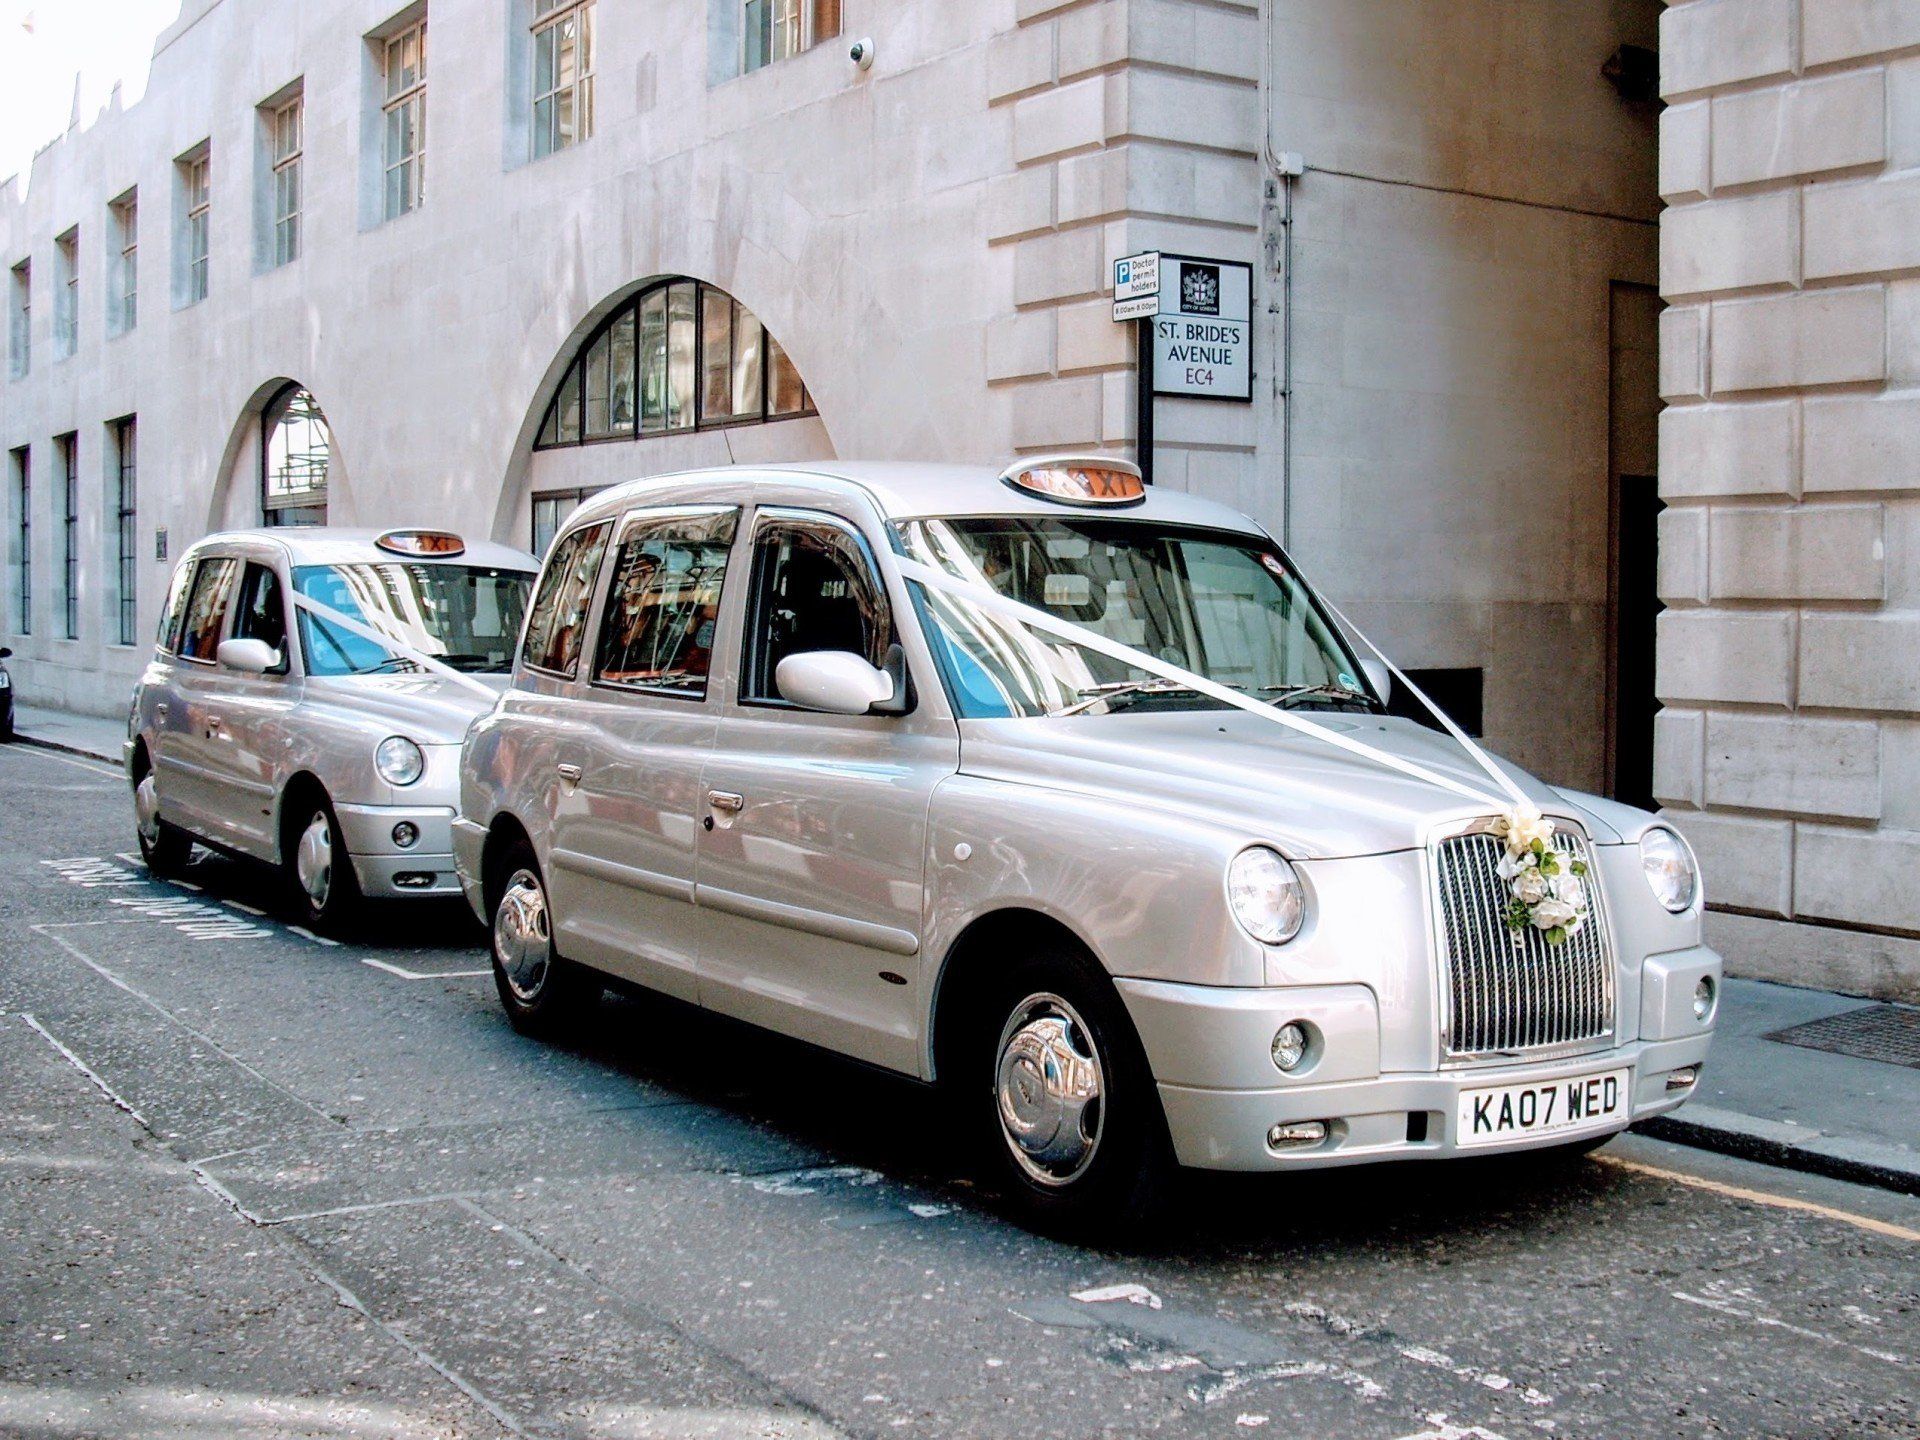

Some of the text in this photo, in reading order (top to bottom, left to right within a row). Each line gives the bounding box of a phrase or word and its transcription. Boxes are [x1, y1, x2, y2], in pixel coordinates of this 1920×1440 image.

[1132, 258, 1155, 270] Doctor
[1132, 269, 1155, 281] permit
[1131, 281, 1157, 292] holders
[1159, 322, 1240, 344] ST. BRIDE'S
[1167, 345, 1232, 365] AVENUE
[1186, 368, 1214, 385] EC4
[1473, 1076, 1618, 1134] KA07 WED
